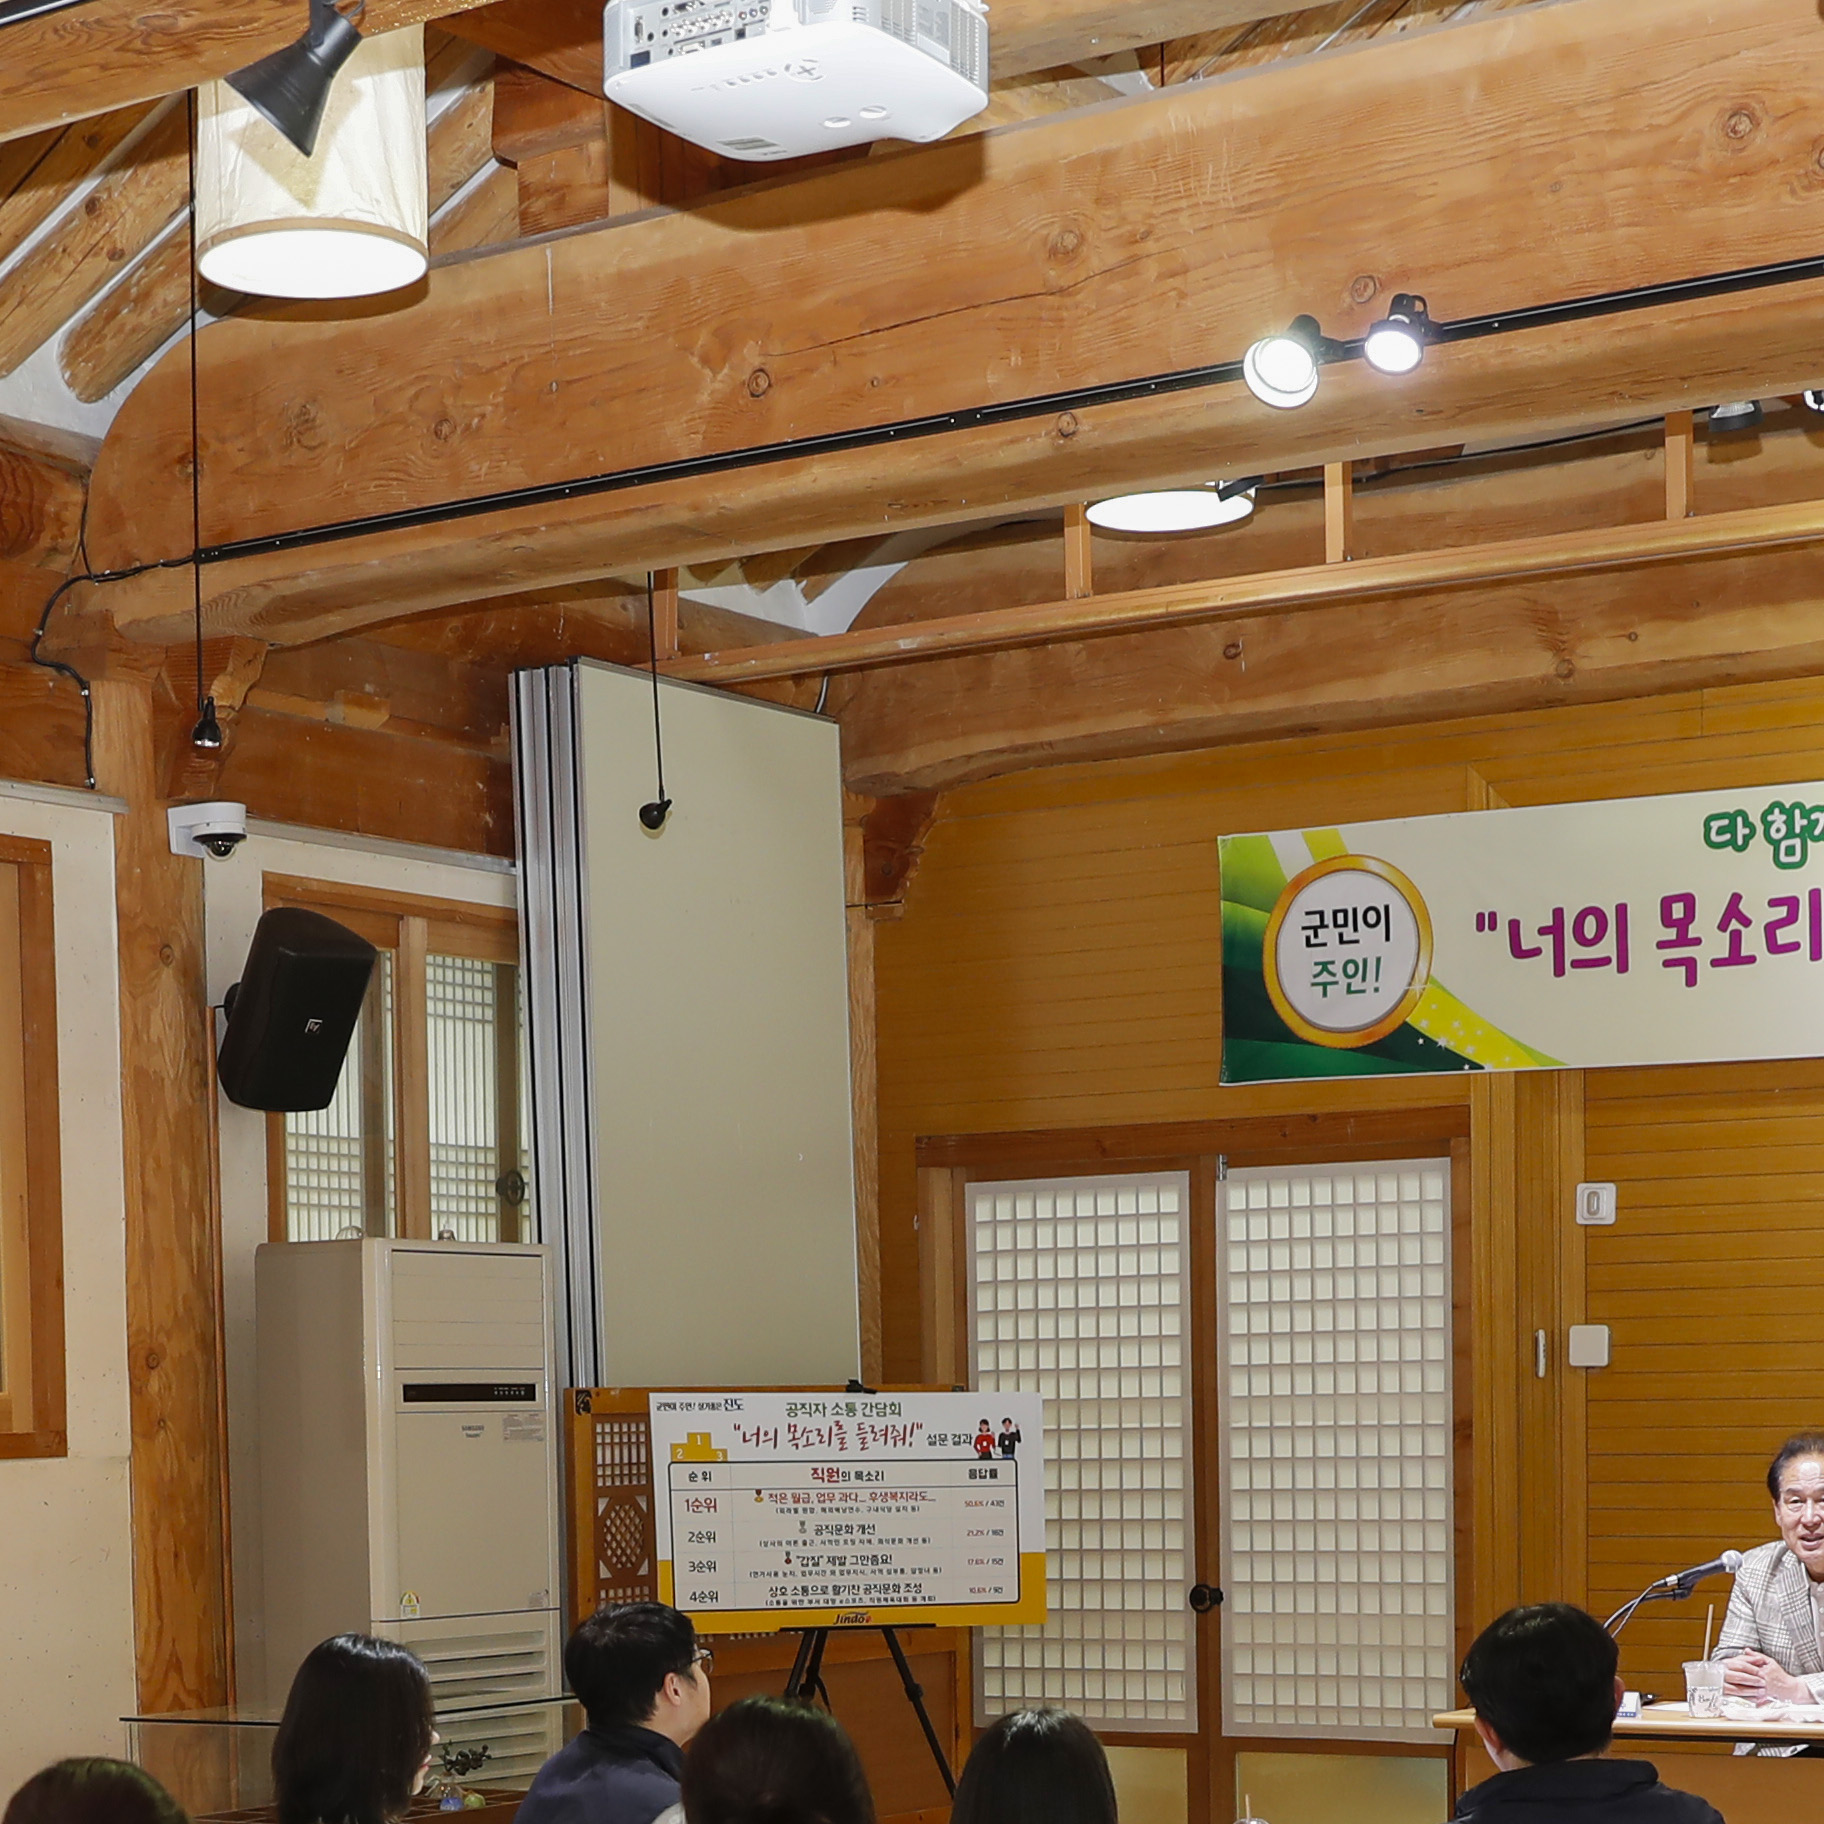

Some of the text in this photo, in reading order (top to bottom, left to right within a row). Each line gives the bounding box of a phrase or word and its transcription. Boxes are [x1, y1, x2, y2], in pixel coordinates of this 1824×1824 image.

[1301, 904, 1391, 948] 군민이
[1475, 902, 1629, 978] "너의
[1310, 956, 1382, 998] 주인!
[723, 1398, 745, 1411] 진도
[785, 1401, 902, 1418] 공직자 소통 간담회
[733, 1420, 973, 1451] "너의 목소리를 들려줘!" 설문 결과
[811, 1467, 884, 1483] 직원의 목소리
[684, 1497, 718, 1513] 1순위
[768, 1492, 788, 1504] 적은
[815, 1492, 836, 1504] 업무
[813, 1524, 876, 1535] 공직문화 개선
[687, 1531, 716, 1543] 2순위
[688, 1560, 717, 1573] 3순위
[826, 1555, 847, 1566] 제발
[689, 1590, 719, 1603] 4순위
[768, 1586, 789, 1597] 상호
[791, 1585, 829, 1597] 소통으로
[863, 1583, 902, 1595] 공직문화
[904, 1583, 922, 1594] 조성
